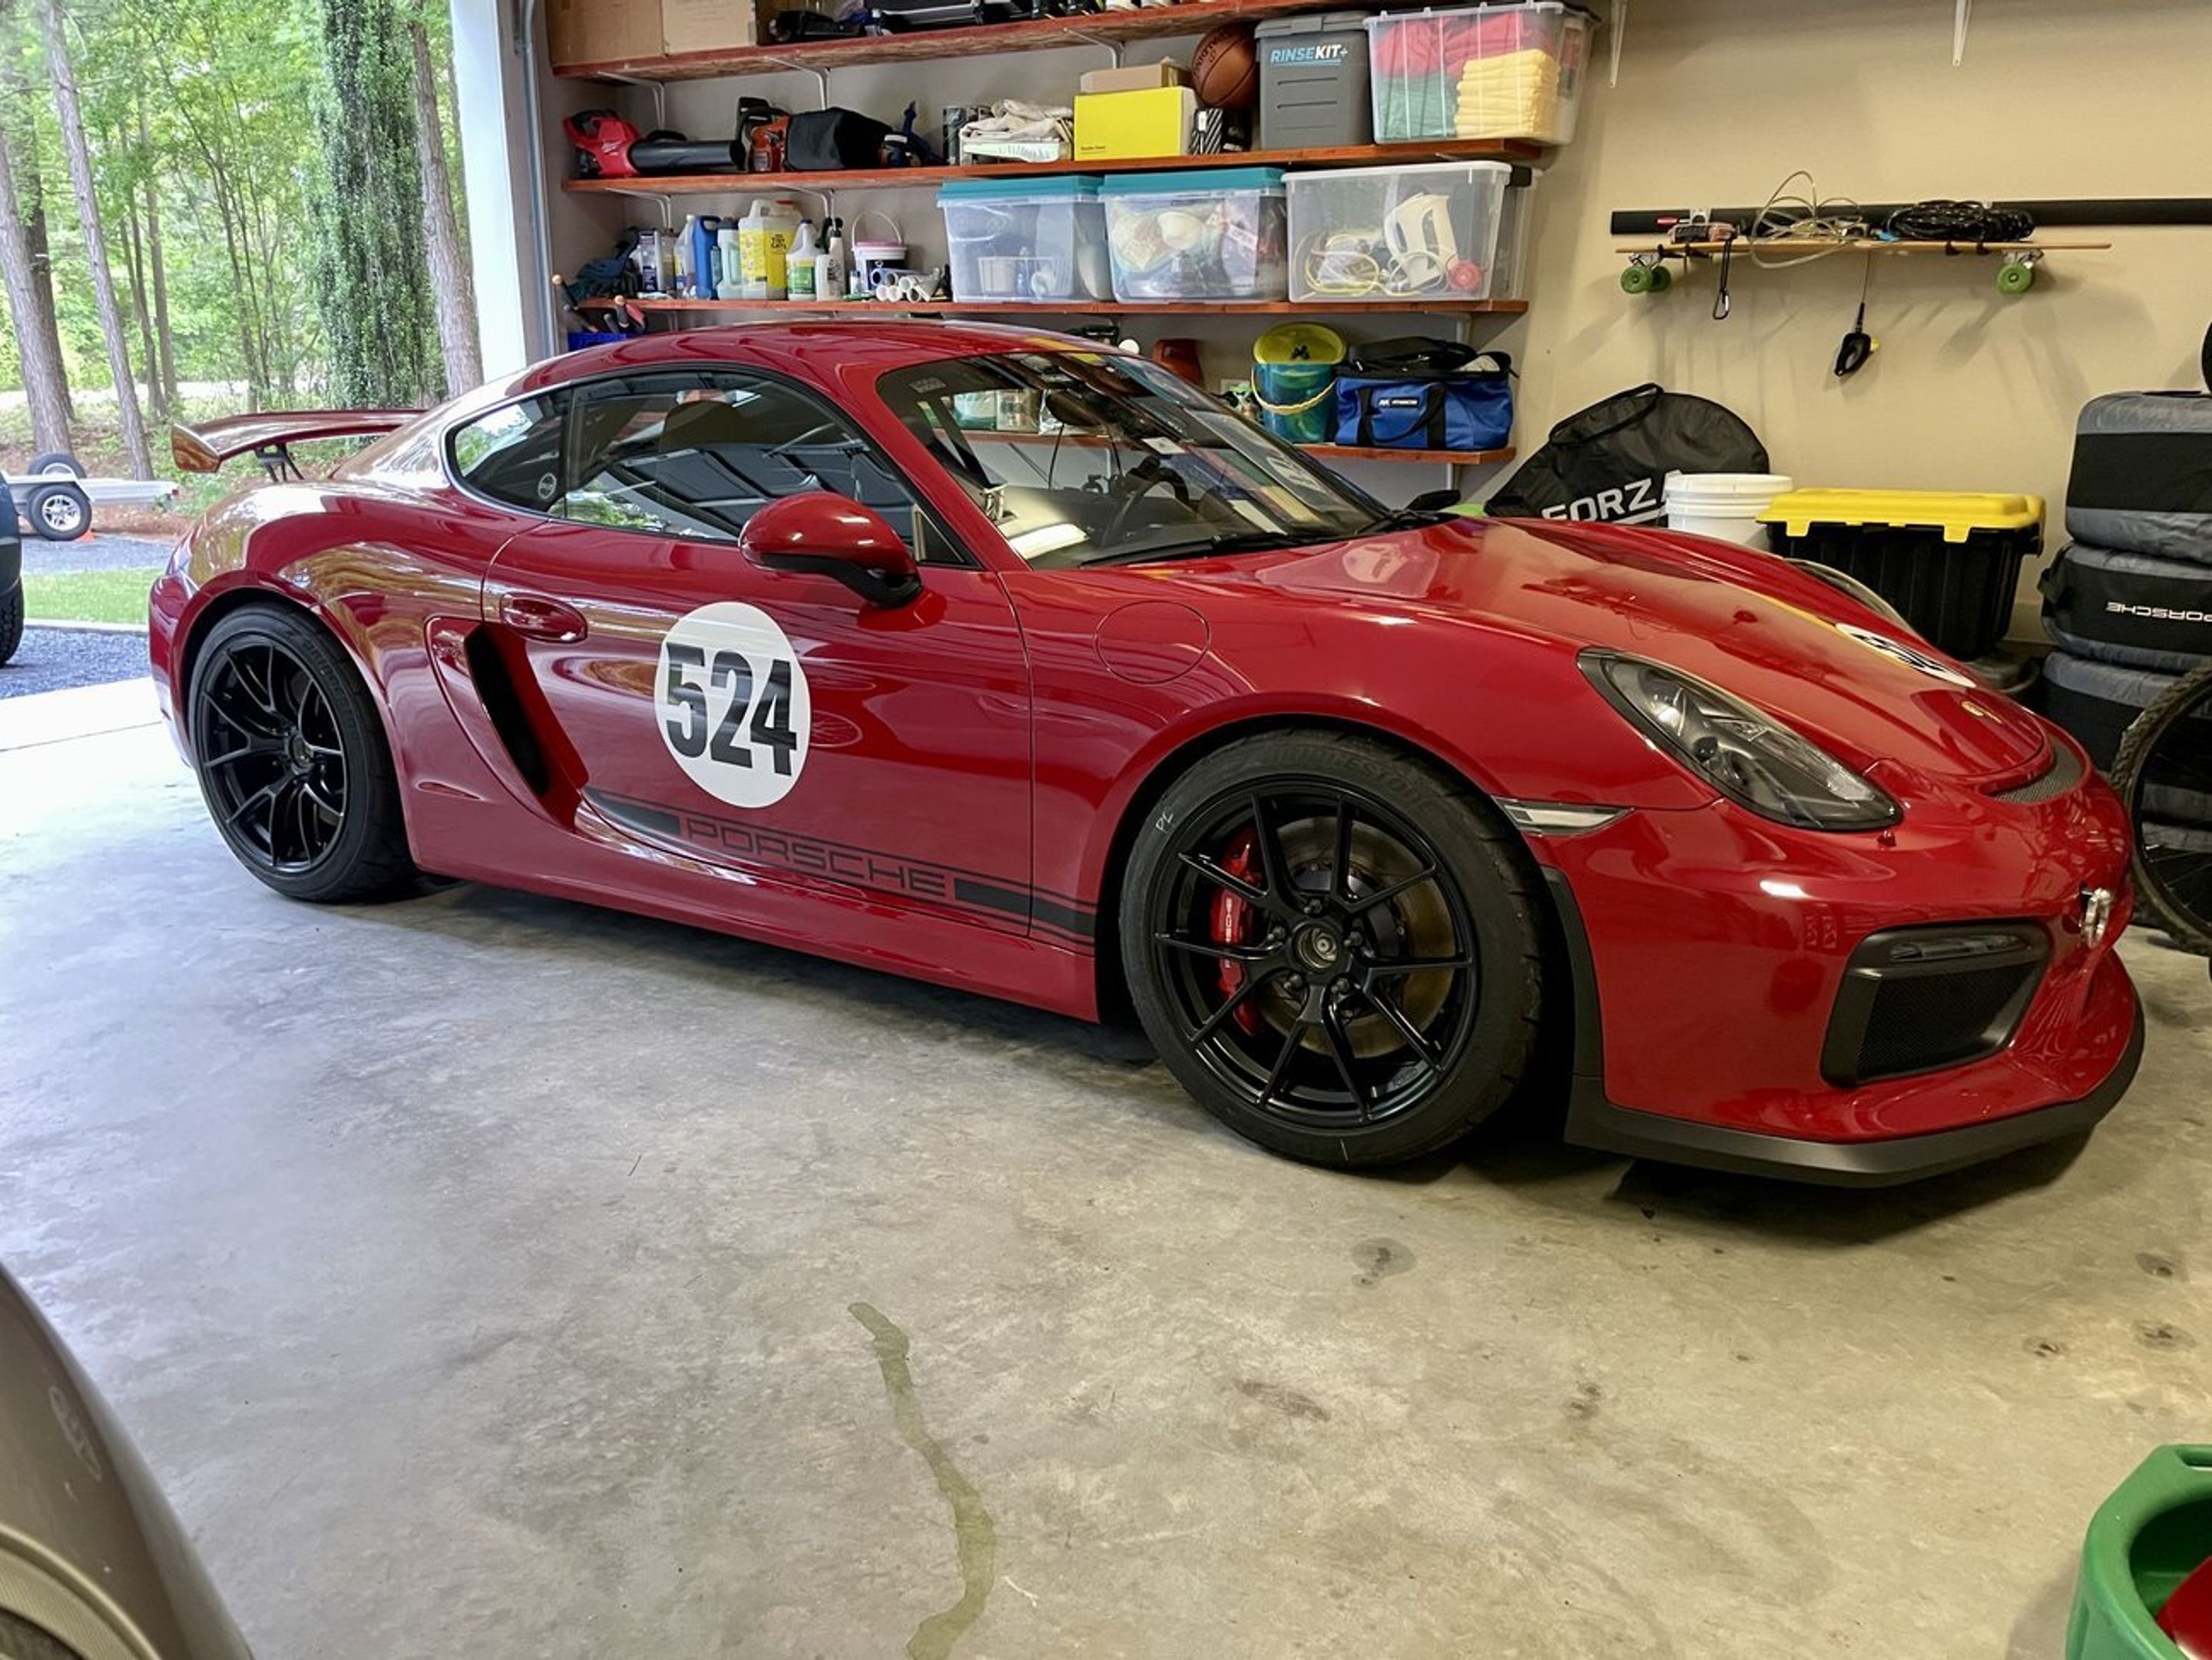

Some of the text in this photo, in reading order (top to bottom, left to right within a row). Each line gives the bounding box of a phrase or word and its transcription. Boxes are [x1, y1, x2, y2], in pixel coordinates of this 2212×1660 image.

[1270, 45, 1348, 63] RINSEKIT+
[665, 641, 797, 777] 524
[688, 820, 945, 896] PORSCHE
